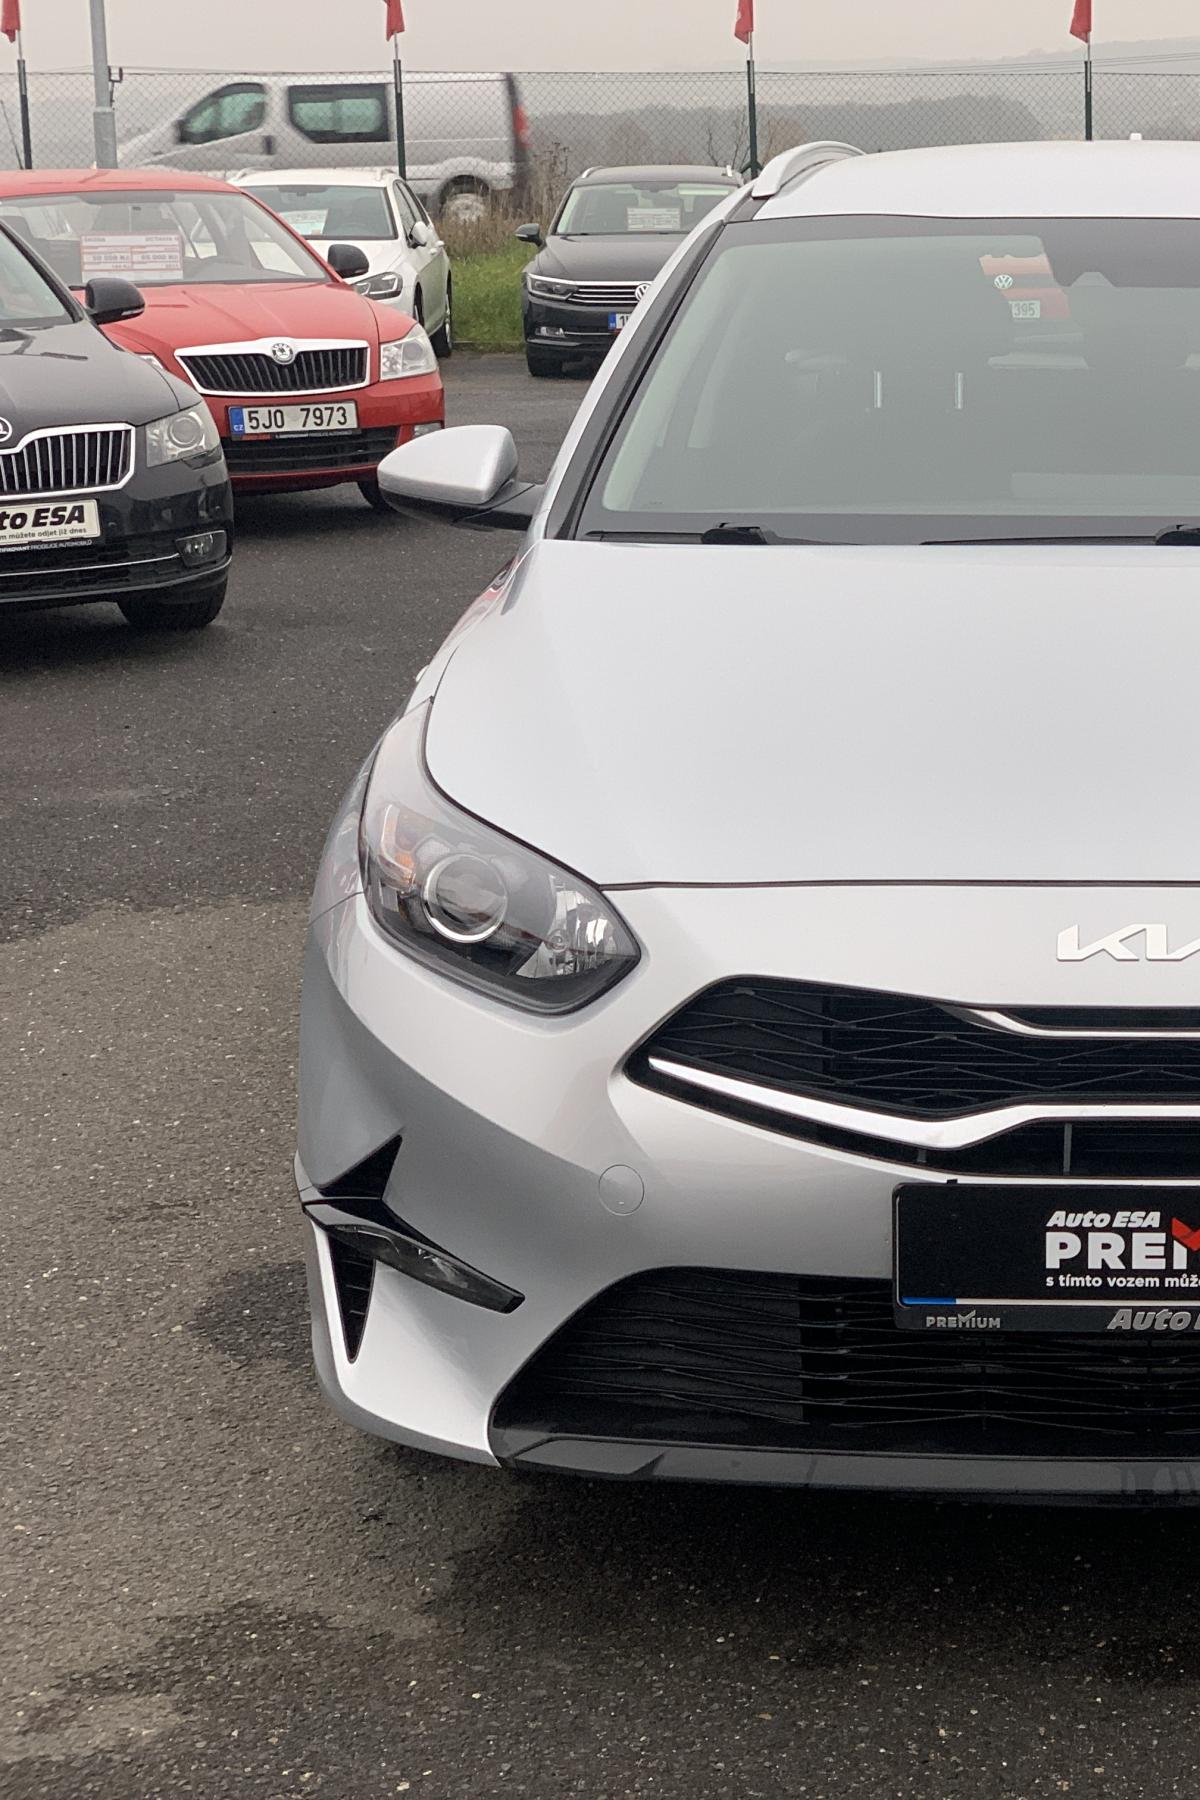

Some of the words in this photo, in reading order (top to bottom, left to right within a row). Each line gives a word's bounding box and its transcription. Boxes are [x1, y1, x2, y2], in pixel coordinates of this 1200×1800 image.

[233, 424, 244, 432] CZ
[300, 406, 348, 428] 7973
[32, 505, 85, 528] ESA
[38, 528, 57, 537] odjet
[1046, 1210, 1111, 1228] Auto
[1112, 1211, 1161, 1228] ESA
[1045, 1277, 1054, 1287] s
[1059, 1274, 1102, 1288] tímto
[1107, 1276, 1160, 1288] vozem
[926, 1312, 1001, 1328] PREMIUM
[1107, 1308, 1191, 1331] Auto
